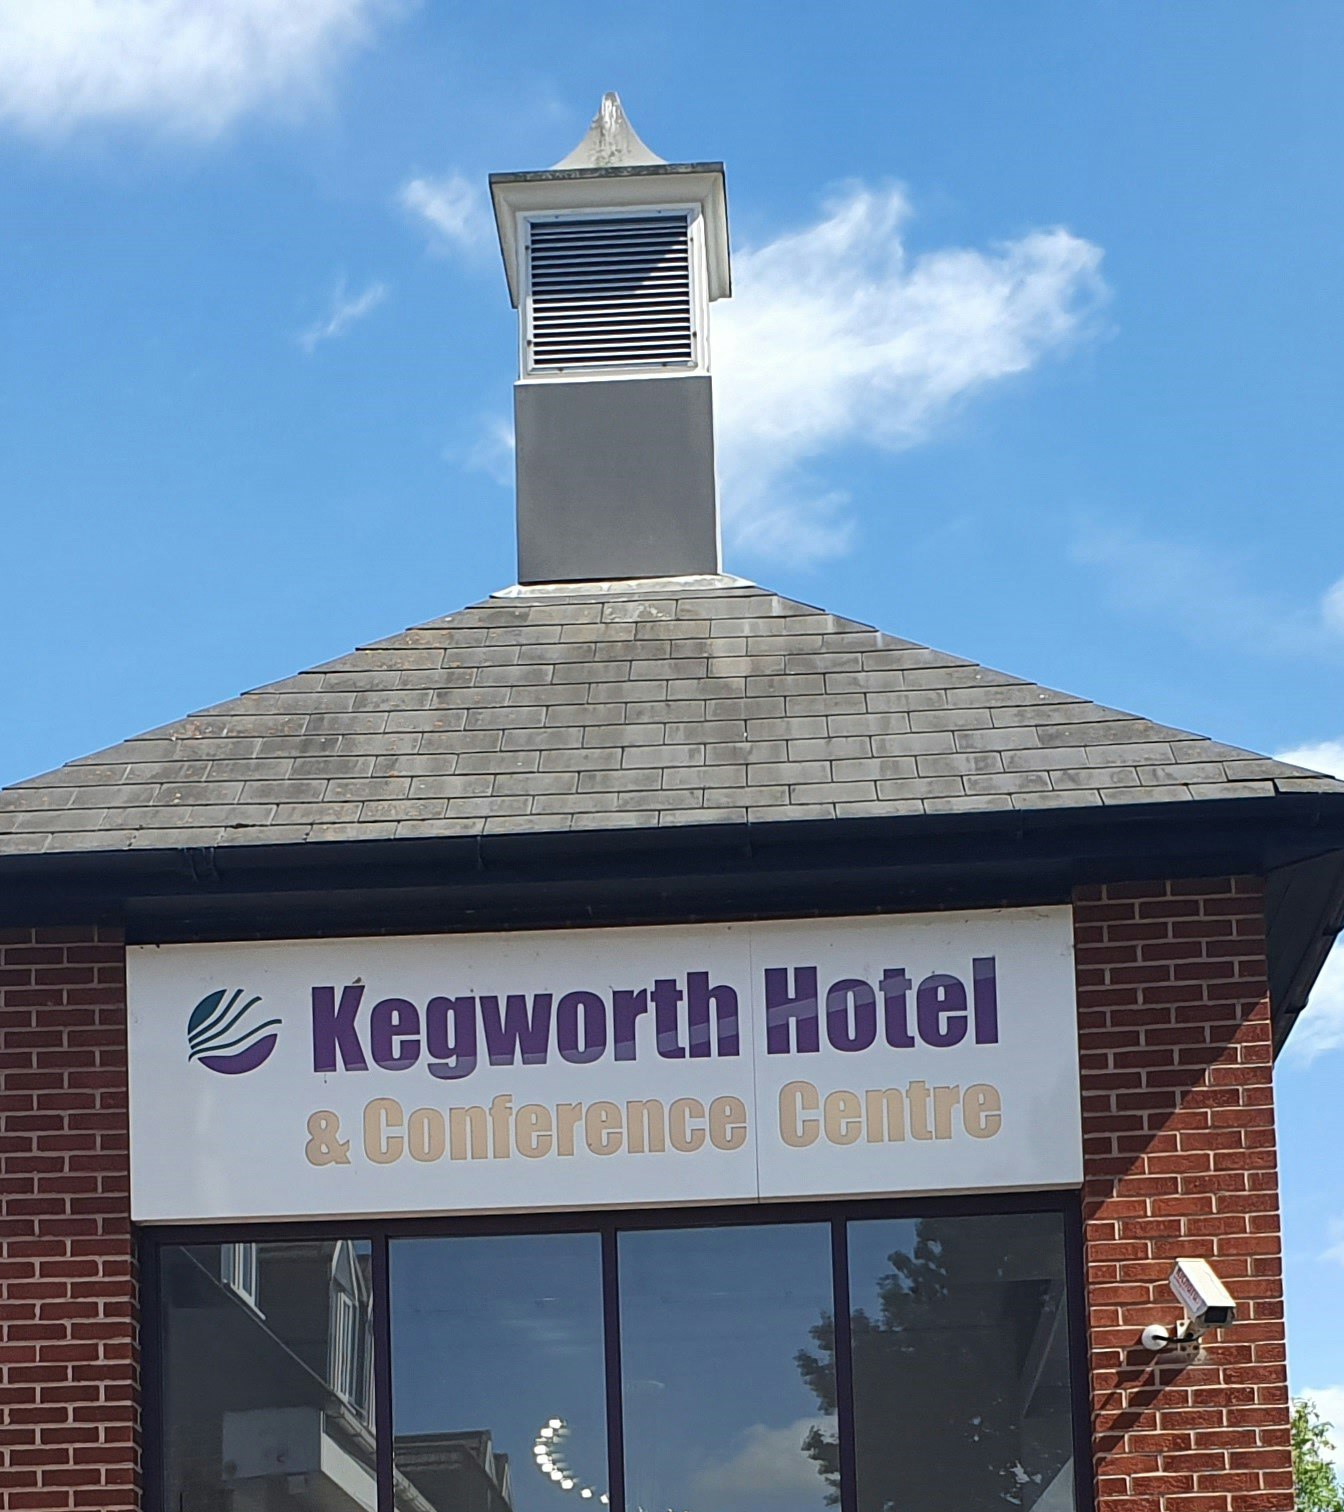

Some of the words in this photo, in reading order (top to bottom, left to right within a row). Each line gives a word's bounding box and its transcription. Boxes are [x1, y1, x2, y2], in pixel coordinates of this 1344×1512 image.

[311, 971, 741, 1080] Kegworth
[763, 956, 999, 1055] Hotel
[304, 1110, 352, 1167] &
[362, 1095, 748, 1165] Conference
[778, 1080, 1002, 1148] Centre
